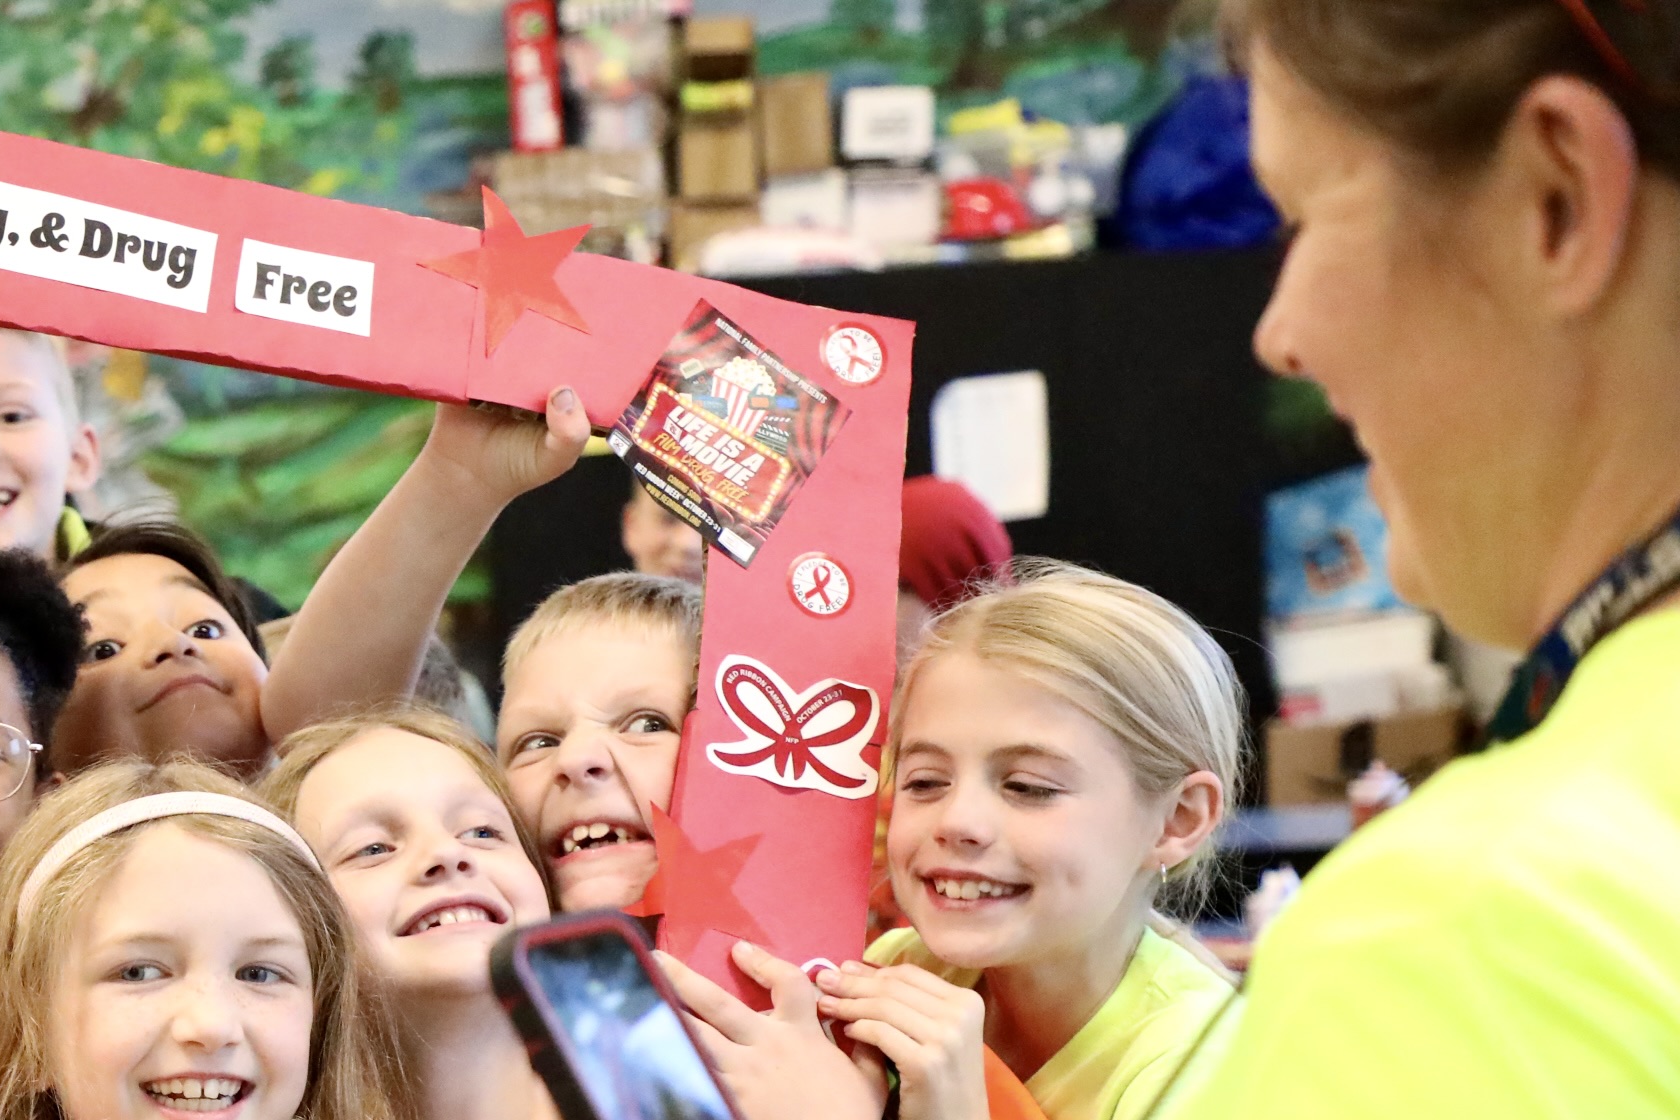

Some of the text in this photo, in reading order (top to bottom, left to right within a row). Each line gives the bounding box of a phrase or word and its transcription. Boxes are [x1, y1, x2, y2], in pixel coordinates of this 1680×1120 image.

[29, 212, 69, 252] &
[78, 218, 197, 289] Drug
[253, 261, 358, 317] Free
[668, 406, 765, 474] LIFE IS A
[679, 434, 755, 490] MOVIE.
[681, 454, 715, 484] DRUG
[716, 478, 750, 500] FREE
[793, 584, 845, 612] DRUG FREE!
[726, 668, 792, 722] RED RIBBON CAMPAIGN
[796, 698, 825, 724] OCTOBER
[785, 736, 800, 744] NFP
